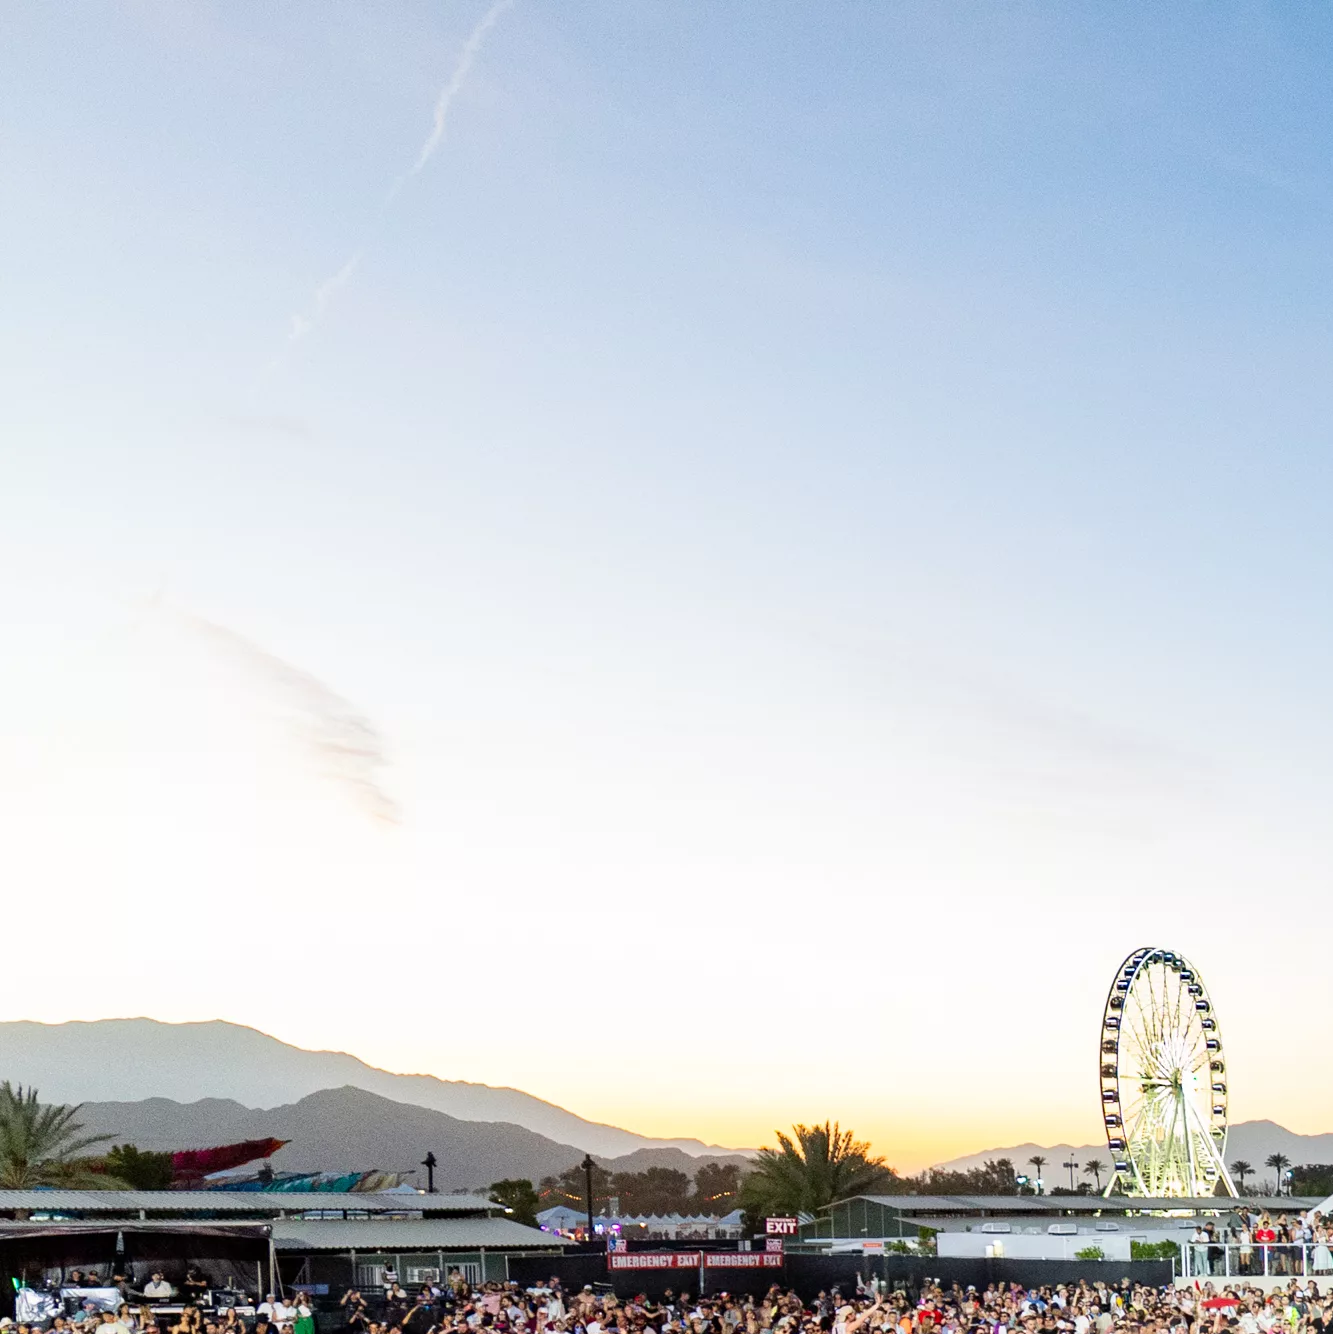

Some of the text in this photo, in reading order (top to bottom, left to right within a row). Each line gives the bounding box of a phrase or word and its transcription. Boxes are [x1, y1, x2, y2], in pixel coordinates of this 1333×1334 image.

[766, 1222, 796, 1233] EXIT
[612, 1254, 699, 1268] EMERGENCY EXIT
[706, 1255, 781, 1266] EMERGENCY EXIT
